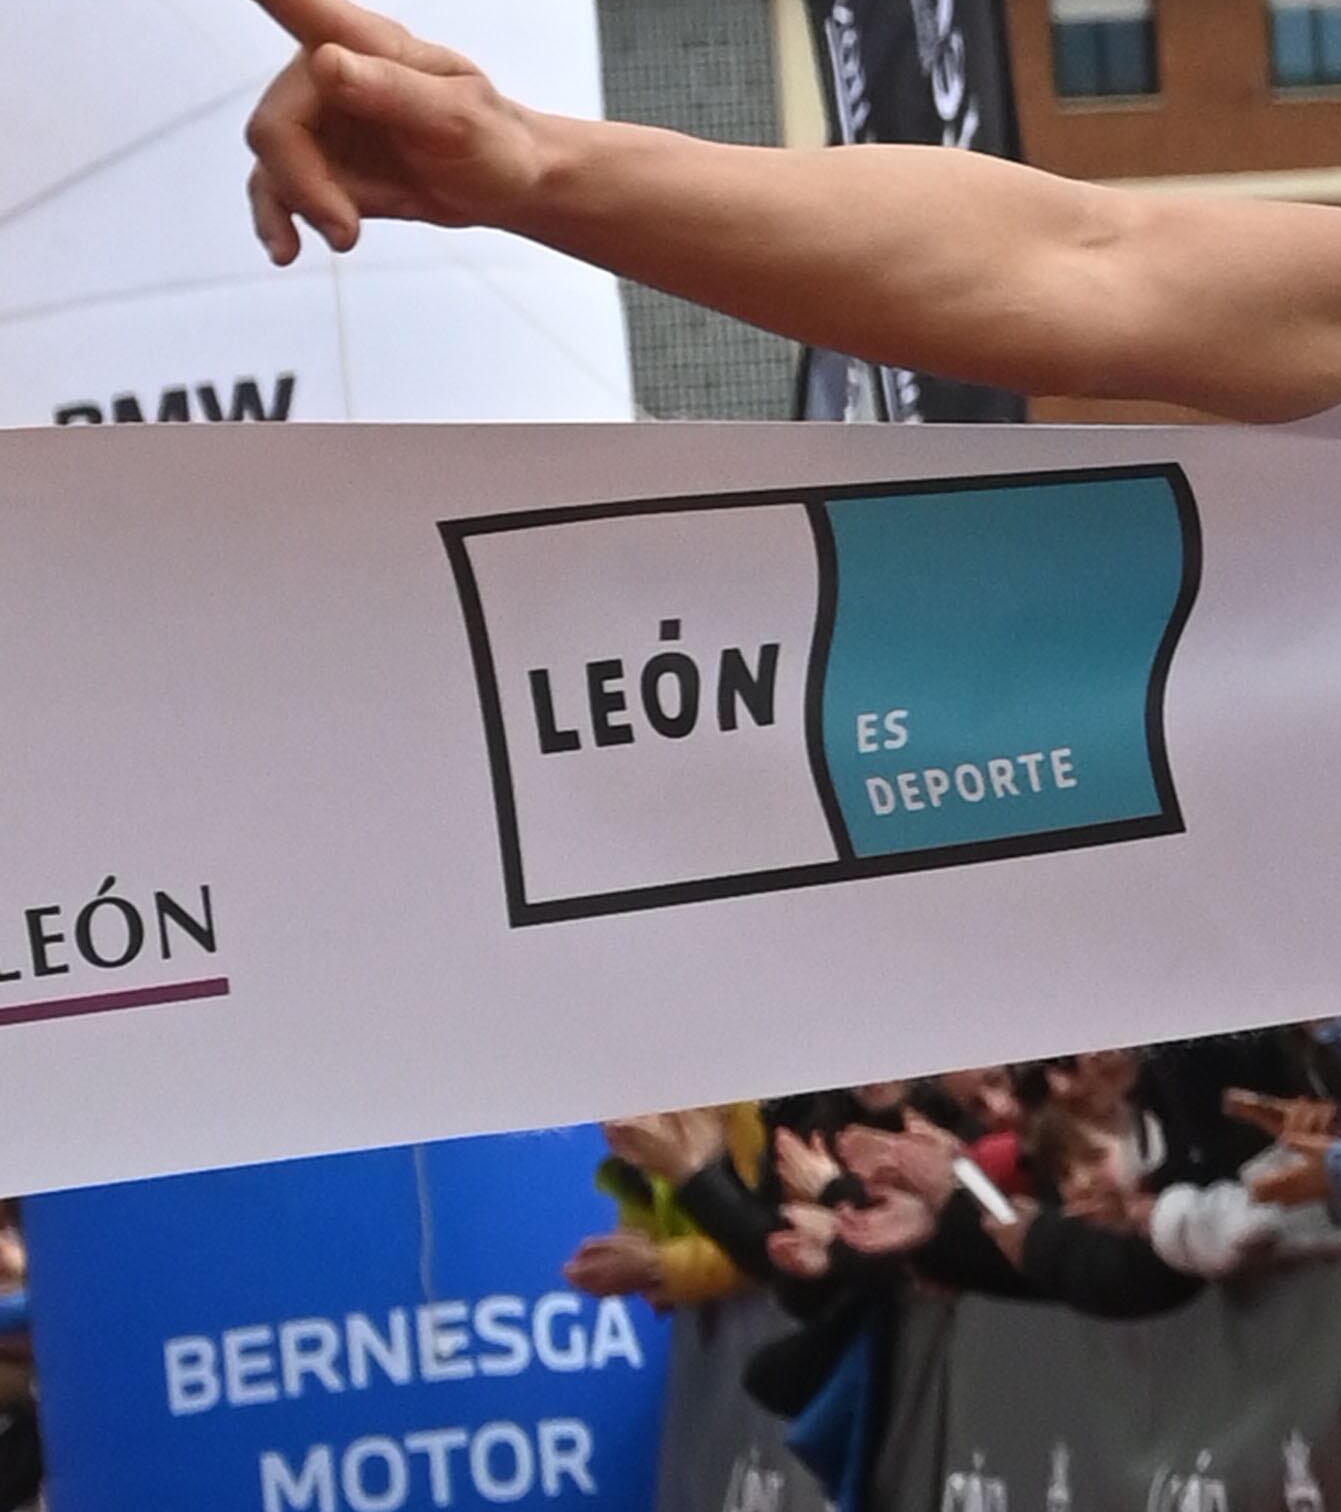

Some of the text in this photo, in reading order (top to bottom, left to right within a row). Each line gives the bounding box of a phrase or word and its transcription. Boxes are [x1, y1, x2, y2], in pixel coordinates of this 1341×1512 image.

[528, 618, 780, 756] LEÓN
[856, 709, 911, 754] ES
[866, 748, 1078, 816] DEPORTE
[163, 1290, 646, 1416] BERNESGA
